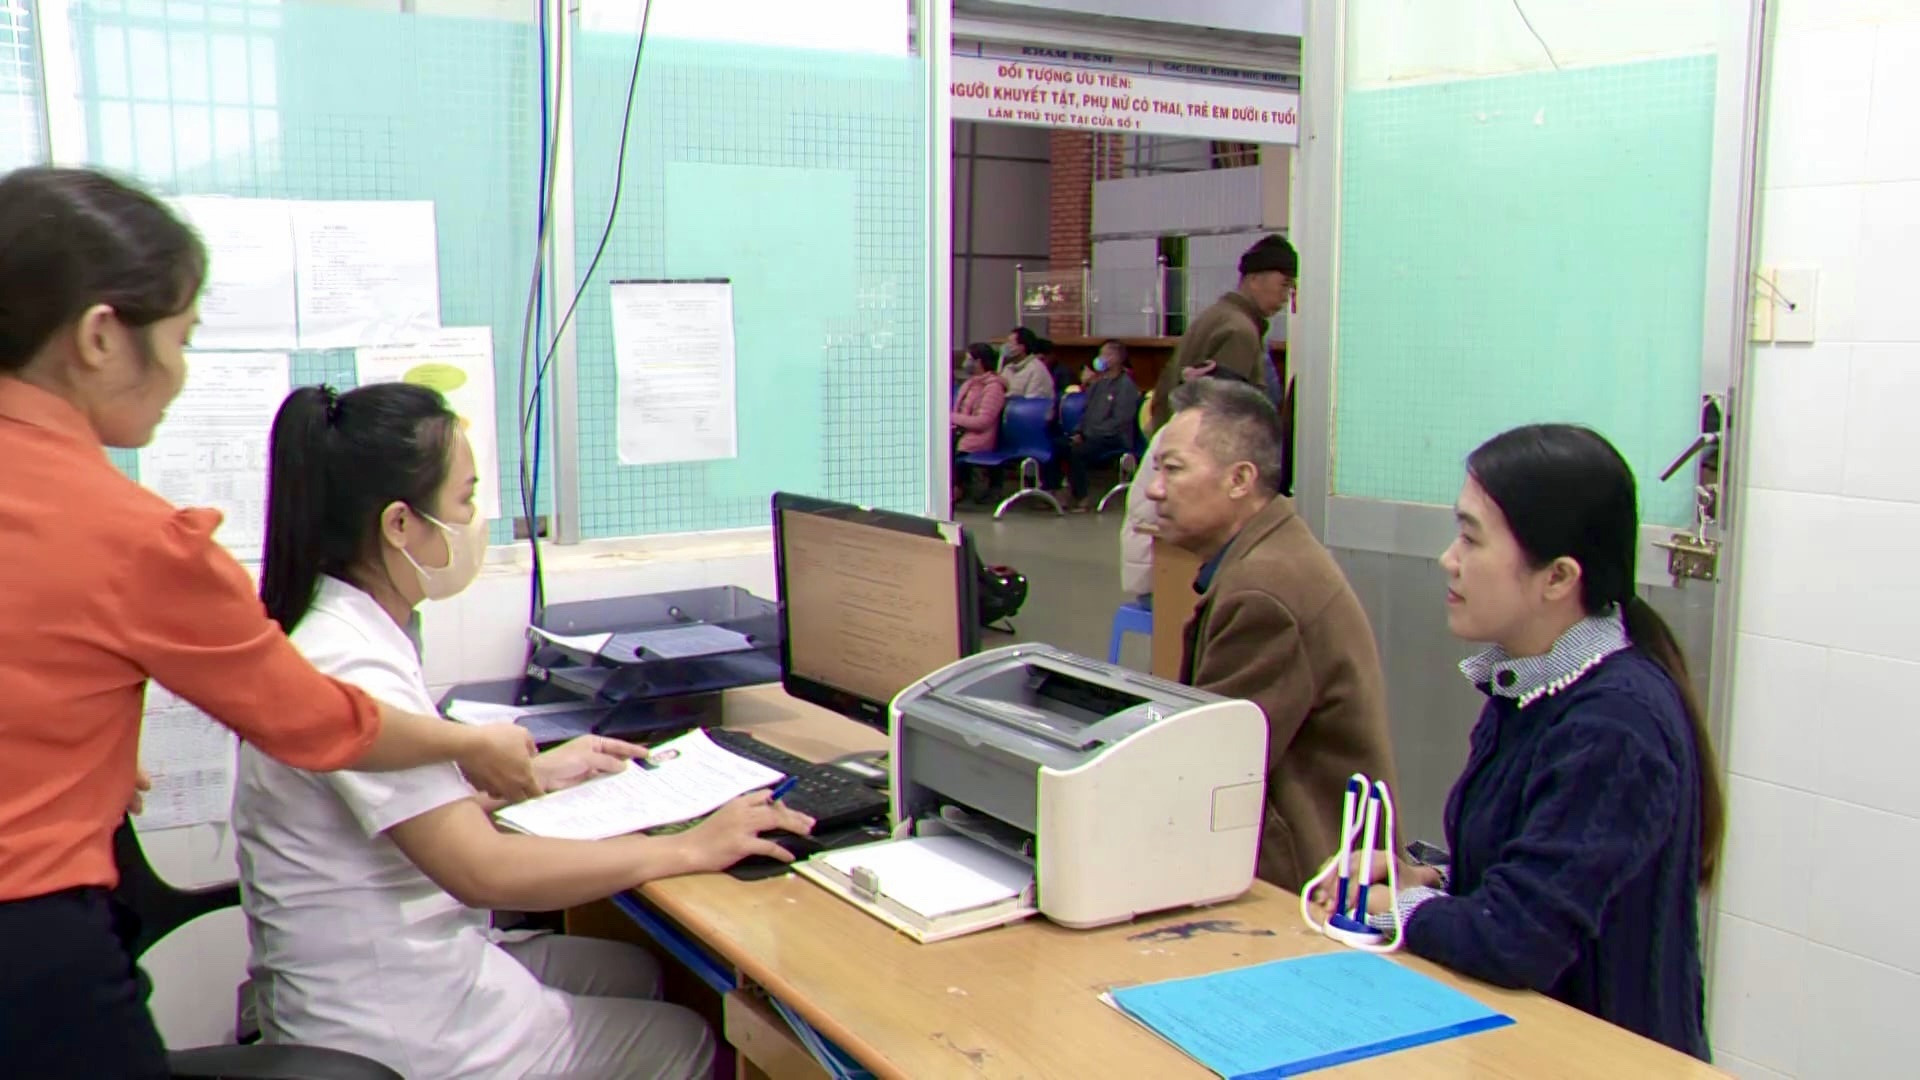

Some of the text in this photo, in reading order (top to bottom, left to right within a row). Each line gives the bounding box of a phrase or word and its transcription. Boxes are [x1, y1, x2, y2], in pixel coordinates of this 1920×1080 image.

[998, 63, 1132, 89] ĐỐI TƯỢNG ƯU TIÊN:
[994, 85, 1048, 104] KHUYẾT
[1052, 91, 1079, 109] TẬT,
[1083, 94, 1108, 113] PHỤ
[1112, 93, 1129, 111] NỮ
[1132, 97, 1149, 113] CÓ
[1152, 101, 1183, 118] THAI,
[1187, 101, 1209, 118] TRẺ
[1212, 104, 1229, 120] EM
[1232, 105, 1258, 122] DƯỚI
[1261, 111, 1268, 123] 6
[1272, 107, 1296, 125] TUỔI
[988, 108, 1013, 120] LÀM
[1017, 109, 1040, 121] THỦ
[1044, 111, 1066, 124] TỤC
[1070, 112, 1089, 128] TẠI
[1091, 113, 1113, 127] CỬA
[1117, 116, 1131, 129] SỐ
